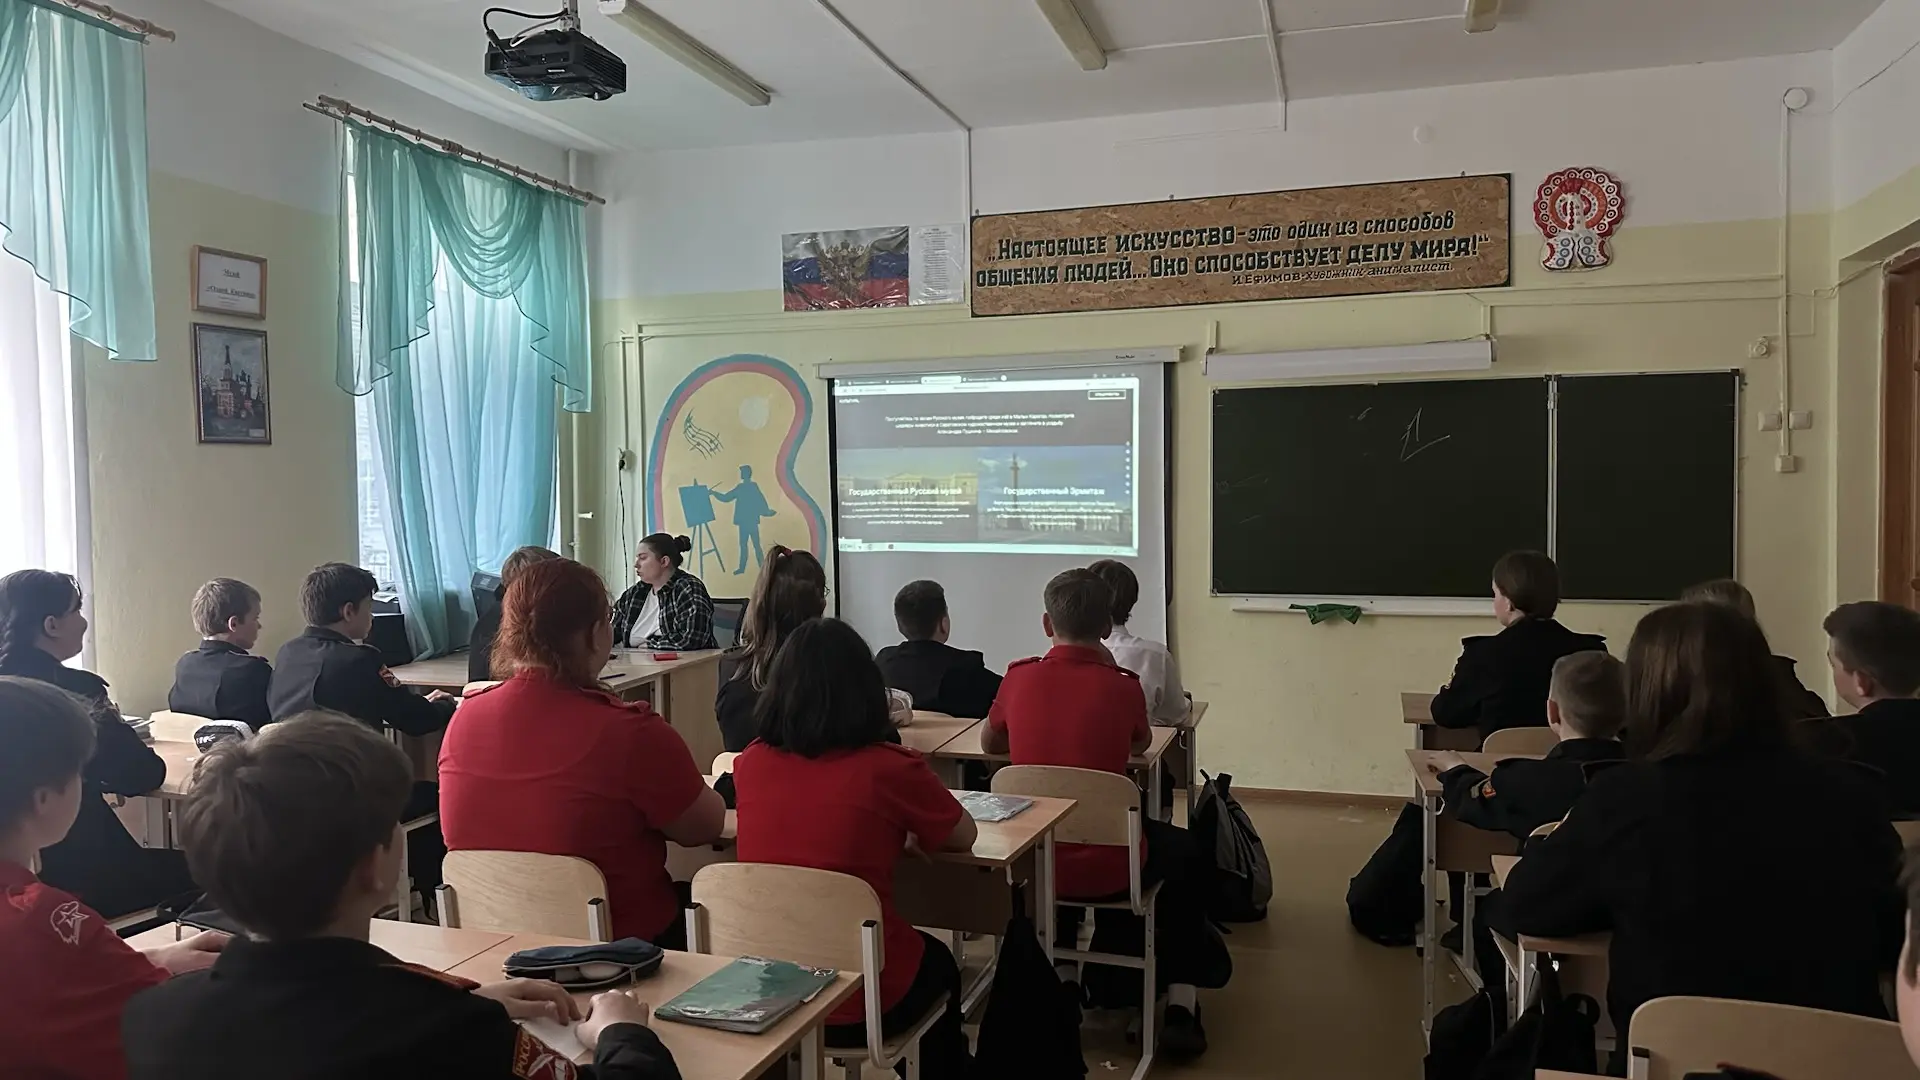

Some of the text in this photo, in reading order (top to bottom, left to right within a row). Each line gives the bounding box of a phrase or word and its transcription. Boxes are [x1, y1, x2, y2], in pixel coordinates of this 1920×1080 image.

[1287, 219, 1332, 240] один
[1336, 219, 1358, 237] из
[1363, 210, 1456, 233] способов
[976, 264, 1060, 288] ОБЩЕНИЯ
[1194, 245, 1342, 275] СПОСОБСТВУЕТ
[1345, 240, 1406, 267] ДЕЛУ
[848, 487, 909, 497] Государственный
[909, 486, 939, 496] Русский
[1003, 486, 1106, 496] Государственный Эрмитаж
